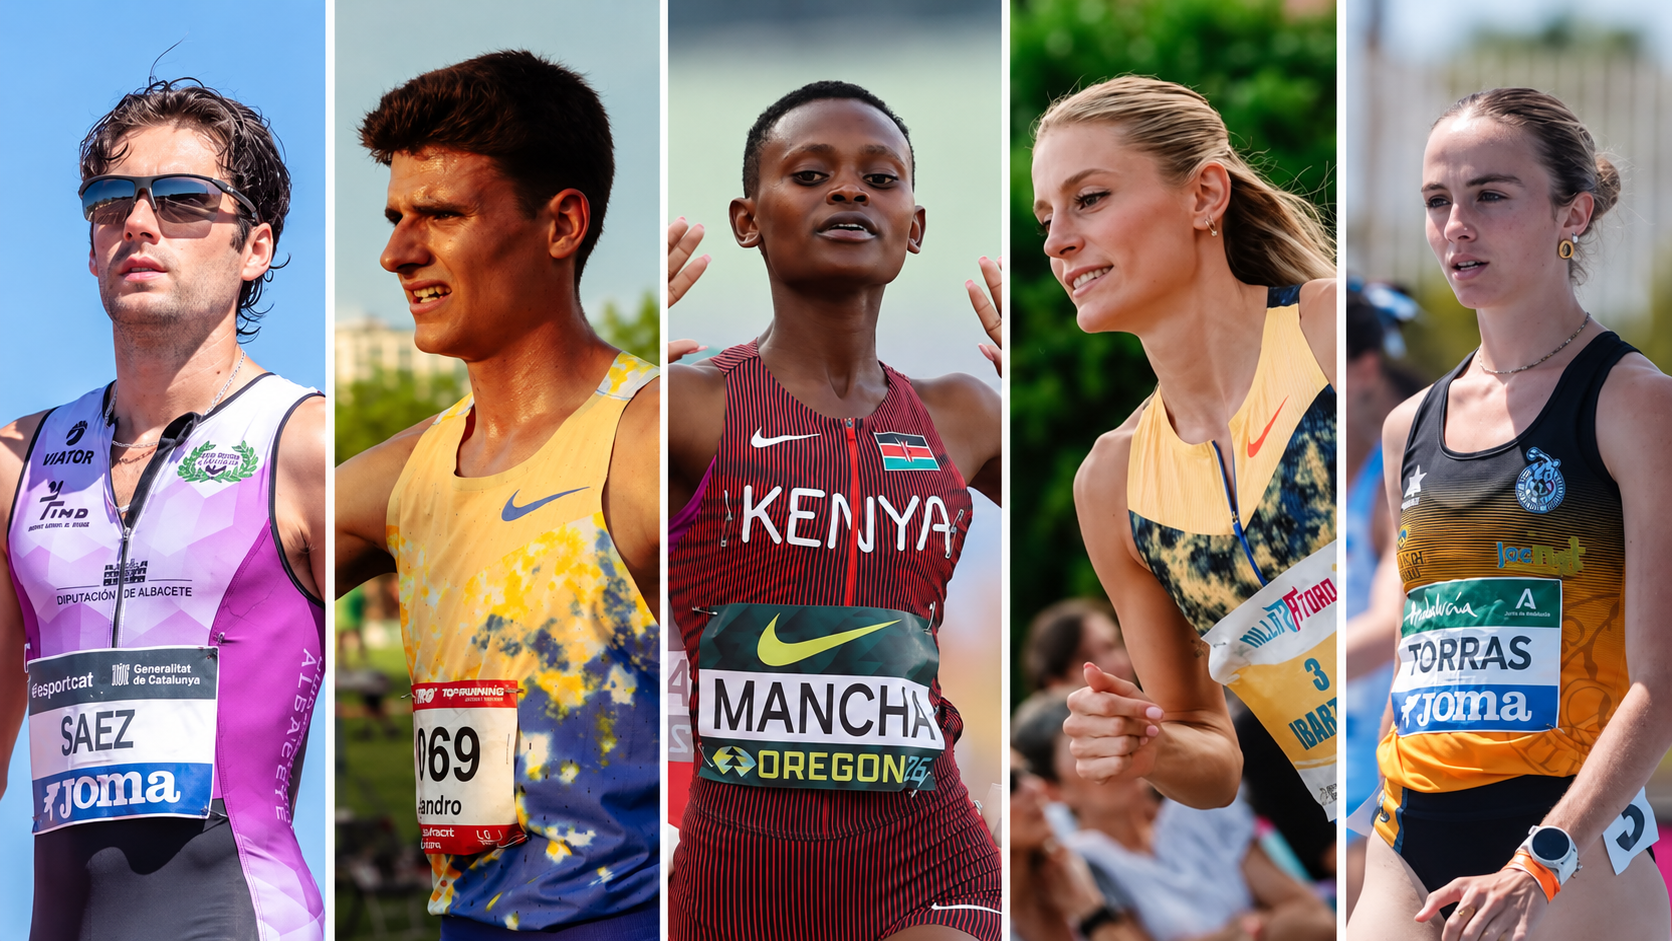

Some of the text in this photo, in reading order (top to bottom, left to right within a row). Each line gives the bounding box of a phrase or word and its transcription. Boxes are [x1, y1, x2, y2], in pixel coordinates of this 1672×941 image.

[42, 449, 94, 466] VIATOR
[742, 485, 952, 559] KENYA
[56, 586, 193, 606] DIPUTACIÓN DE ALBACETE
[133, 663, 192, 674] Generalitat
[1408, 635, 1532, 676] TORRAS
[132, 674, 201, 687] de Catalunya
[1303, 657, 1331, 691] 3
[713, 678, 936, 740] MANCHA
[61, 709, 136, 757] SAEZ
[419, 795, 462, 816] andro
